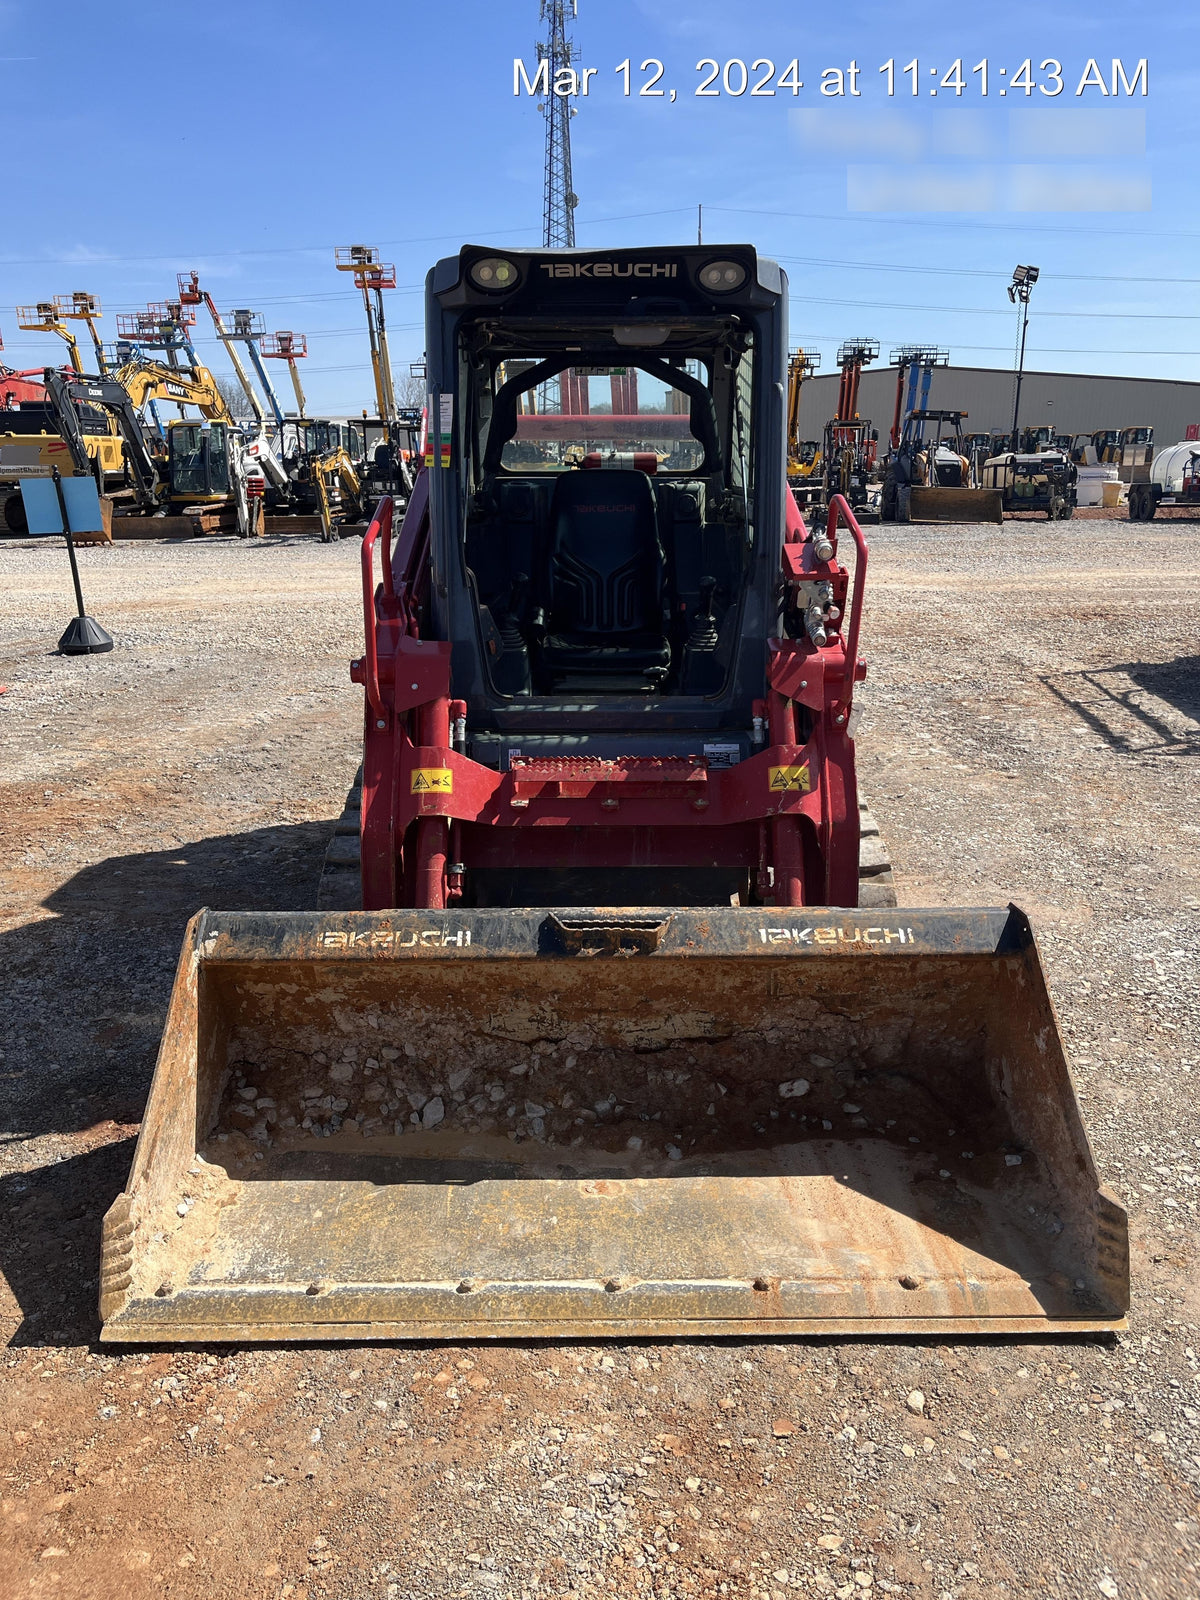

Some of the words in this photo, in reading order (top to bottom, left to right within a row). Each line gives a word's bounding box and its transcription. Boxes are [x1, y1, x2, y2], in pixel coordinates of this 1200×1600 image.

[540, 262, 678, 278] TAKEUCHI
[167, 383, 185, 397] SANY
[757, 927, 915, 945] TAKEUCHI
